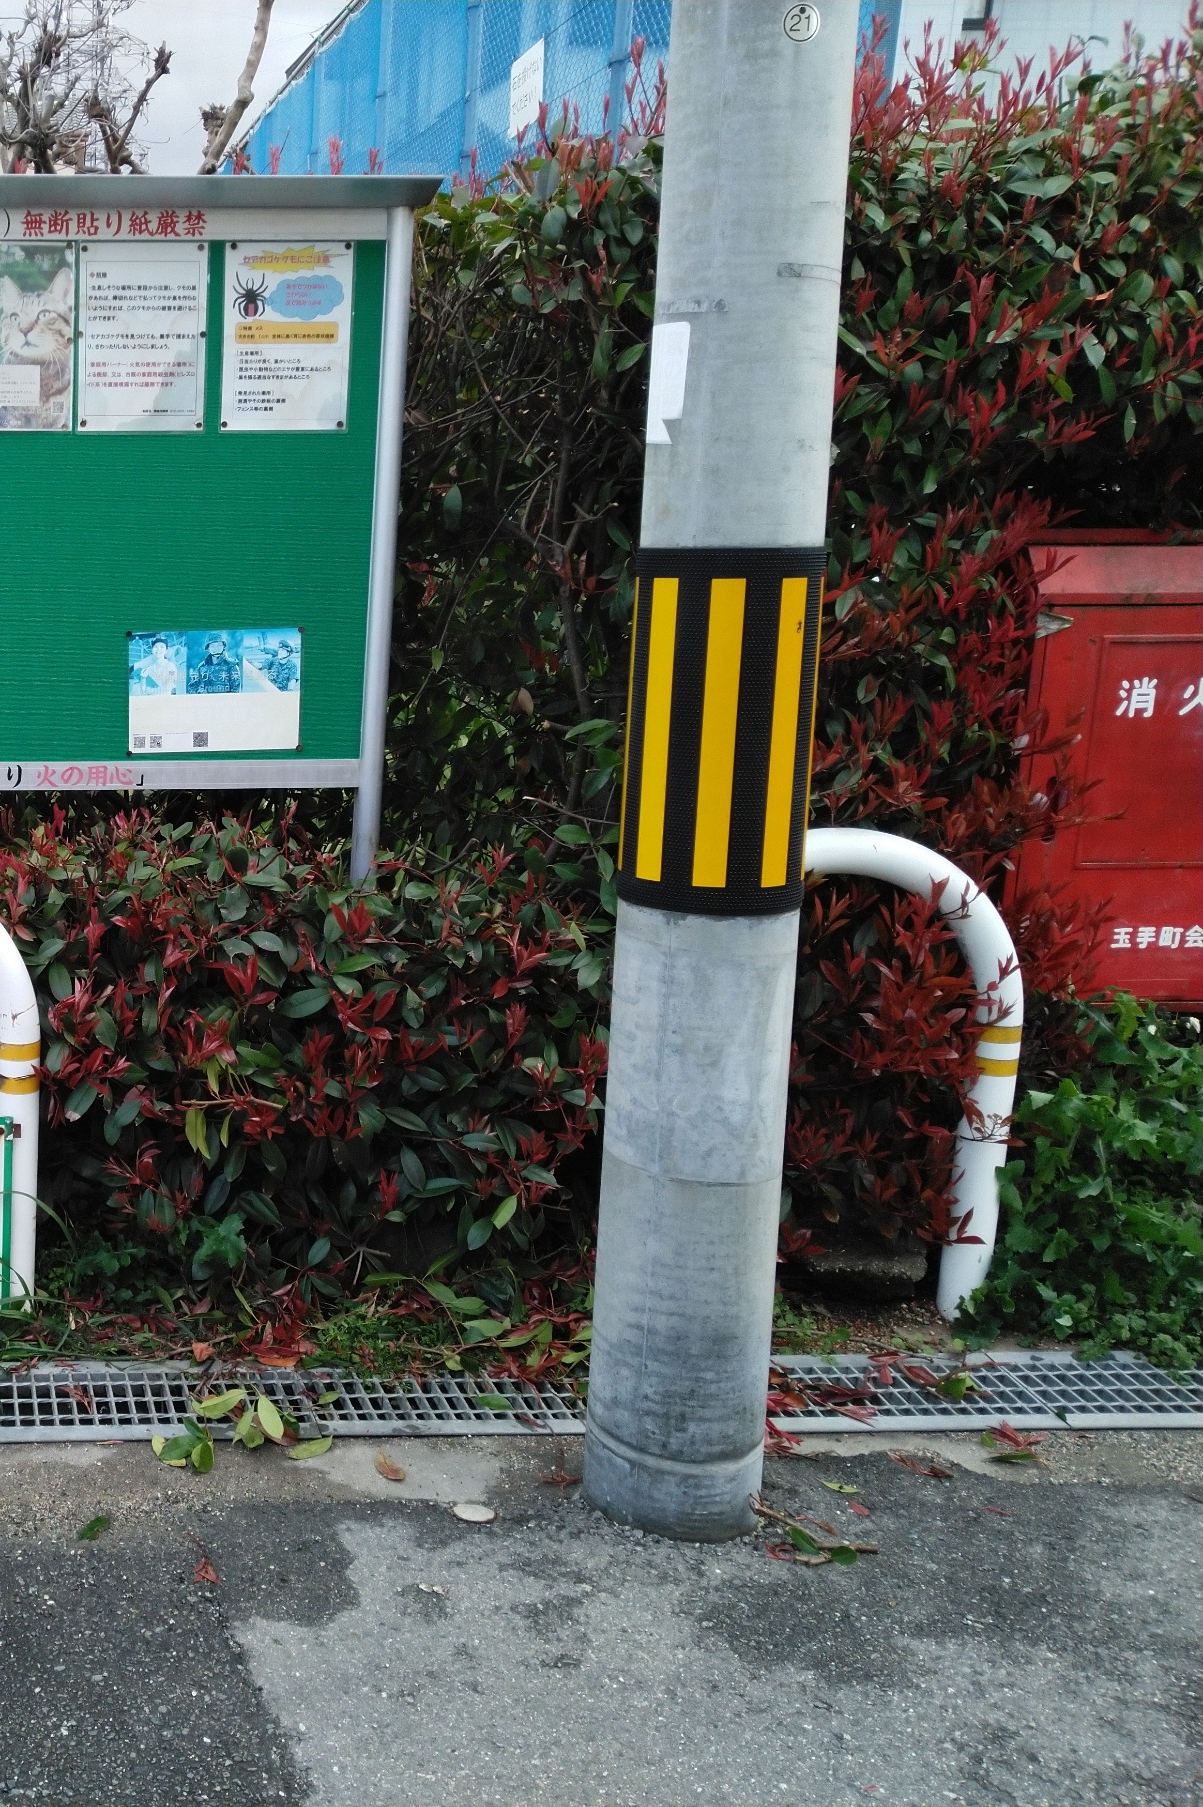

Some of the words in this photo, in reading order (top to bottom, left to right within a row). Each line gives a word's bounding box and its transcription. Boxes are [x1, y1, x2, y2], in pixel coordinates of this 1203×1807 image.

[788, 14, 812, 32] 21
[21, 209, 207, 237] 無断貼り紙厳禁
[1110, 926, 1203, 950] 玉手町会
